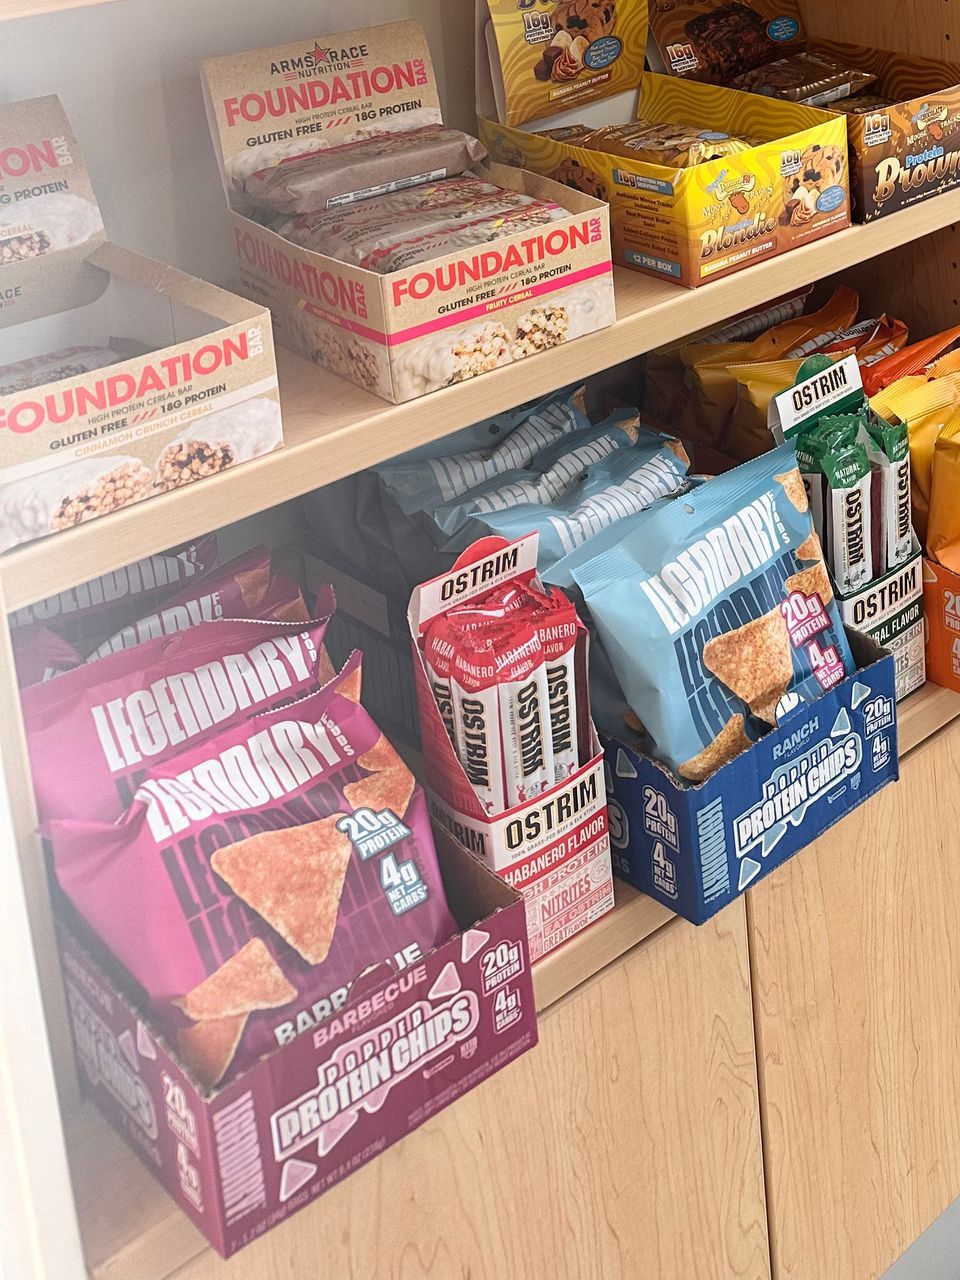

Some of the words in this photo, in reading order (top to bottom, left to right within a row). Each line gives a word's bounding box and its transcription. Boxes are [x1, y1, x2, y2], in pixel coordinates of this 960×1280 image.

[270, 56, 314, 75] ARMS
[329, 44, 369, 63] RACE
[297, 61, 351, 79] NUTRITION
[415, 58, 428, 86] BAR
[223, 61, 416, 128] FOUNDATION
[355, 111, 377, 123] 18G
[379, 99, 422, 117] PROTEIN
[246, 129, 293, 147] GLUTEN
[296, 122, 322, 136] FREE
[906, 145, 944, 168] Protein
[13, 179, 71, 203] PROTEIN
[590, 216, 602, 243] BAR
[392, 222, 590, 308] FOUNDATION
[520, 276, 538, 288] 18G
[539, 263, 572, 282] PROTEIN
[437, 294, 474, 315] GLUTEN
[476, 287, 497, 302] FREE
[485, 296, 508, 312] FRUITY
[508, 289, 534, 305] CEREAL
[87, 410, 110, 426] HIGH
[110, 400, 146, 419] PROTEIN
[146, 392, 176, 409] CEREAL
[177, 384, 194, 398] BAR
[160, 400, 183, 415] 18G
[184, 382, 227, 408] PROTEIN
[792, 365, 847, 412] OSTRIM
[49, 426, 98, 451] GLUTEN
[100, 417, 129, 435] FREE
[74, 431, 134, 459] CINNAMON
[135, 414, 178, 438] CRUNCH
[179, 403, 214, 422] CEREAL
[440, 547, 519, 602] OSTRIM
[781, 592, 818, 629] 20g
[854, 567, 916, 625] OSTRIM
[792, 612, 827, 646] PROTEIN
[892, 604, 919, 634] FLAVOR
[810, 641, 836, 666] 4g
[865, 696, 893, 721] 20g
[772, 717, 820, 760] RANCH
[644, 788, 676, 830] 20g
[740, 773, 807, 846] PROTEIN
[809, 738, 856, 793] CHIPS
[338, 809, 397, 842] 20g
[505, 773, 599, 850] OSTRIM
[358, 823, 410, 859] PROTEIN
[511, 850, 526, 860] 100%
[527, 831, 555, 851] GRASS-FED
[557, 824, 569, 835] BEEF
[574, 814, 583, 824] ELK
[583, 805, 596, 819] STICK
[646, 817, 678, 845] PROTEIN
[379, 855, 418, 888] 4g
[482, 943, 520, 977] 20g
[312, 964, 428, 1049] BARBECUE
[278, 1053, 391, 1150] PROTEIN
[393, 999, 471, 1074] CHIPS
